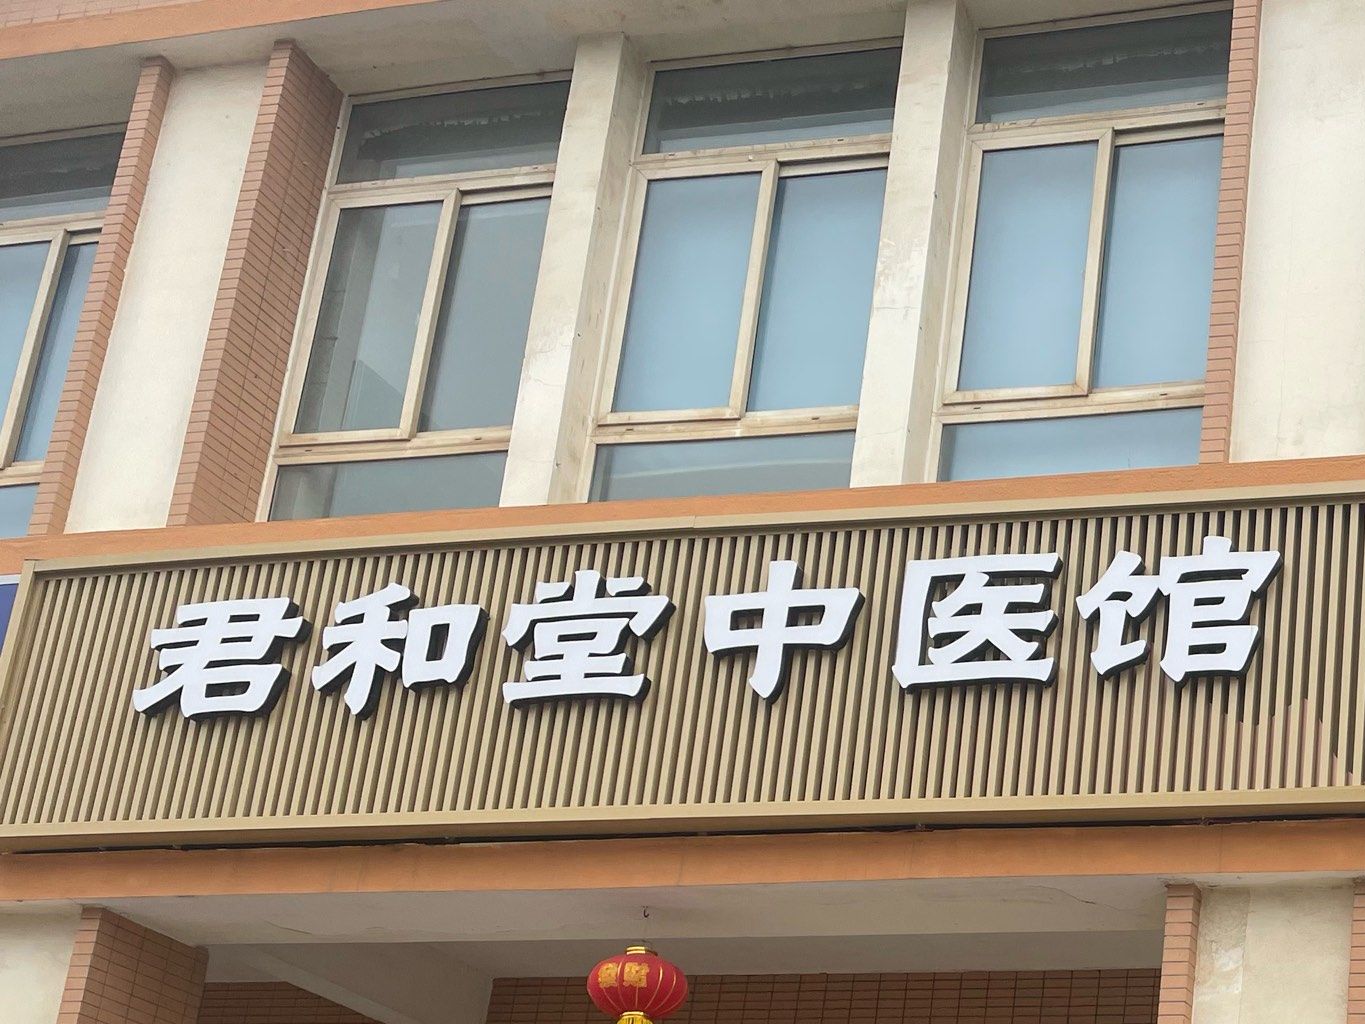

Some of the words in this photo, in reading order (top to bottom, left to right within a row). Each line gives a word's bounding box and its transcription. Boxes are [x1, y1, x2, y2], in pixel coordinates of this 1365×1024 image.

[133, 535, 1282, 720] 君和堂中医馆
